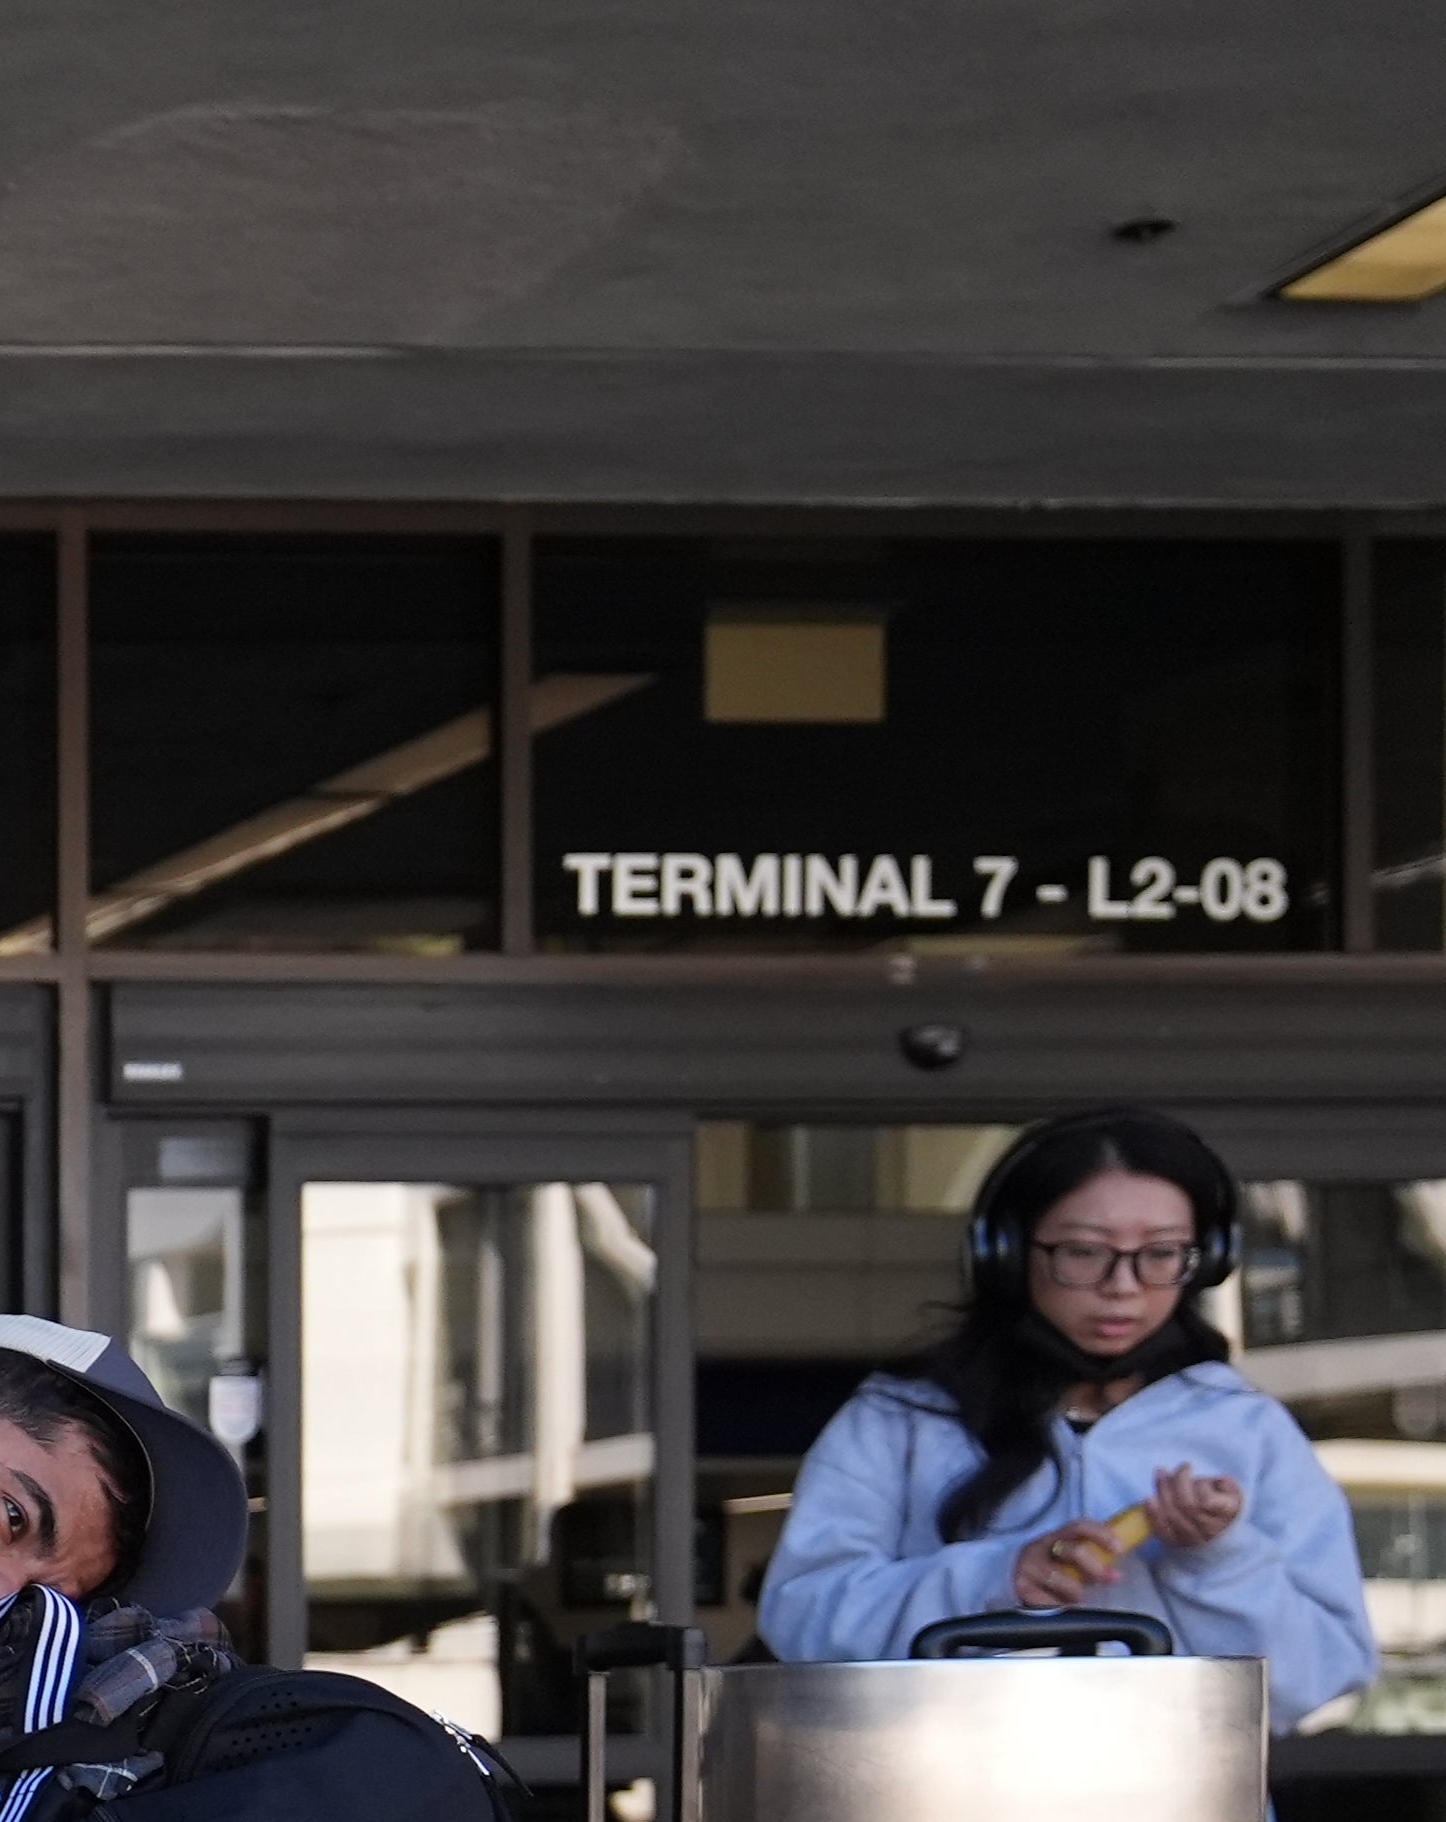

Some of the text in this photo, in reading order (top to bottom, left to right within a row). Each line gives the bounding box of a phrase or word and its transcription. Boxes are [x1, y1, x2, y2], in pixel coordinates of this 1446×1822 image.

[564, 852, 1288, 921] TERMINAL 7 - L2-08
